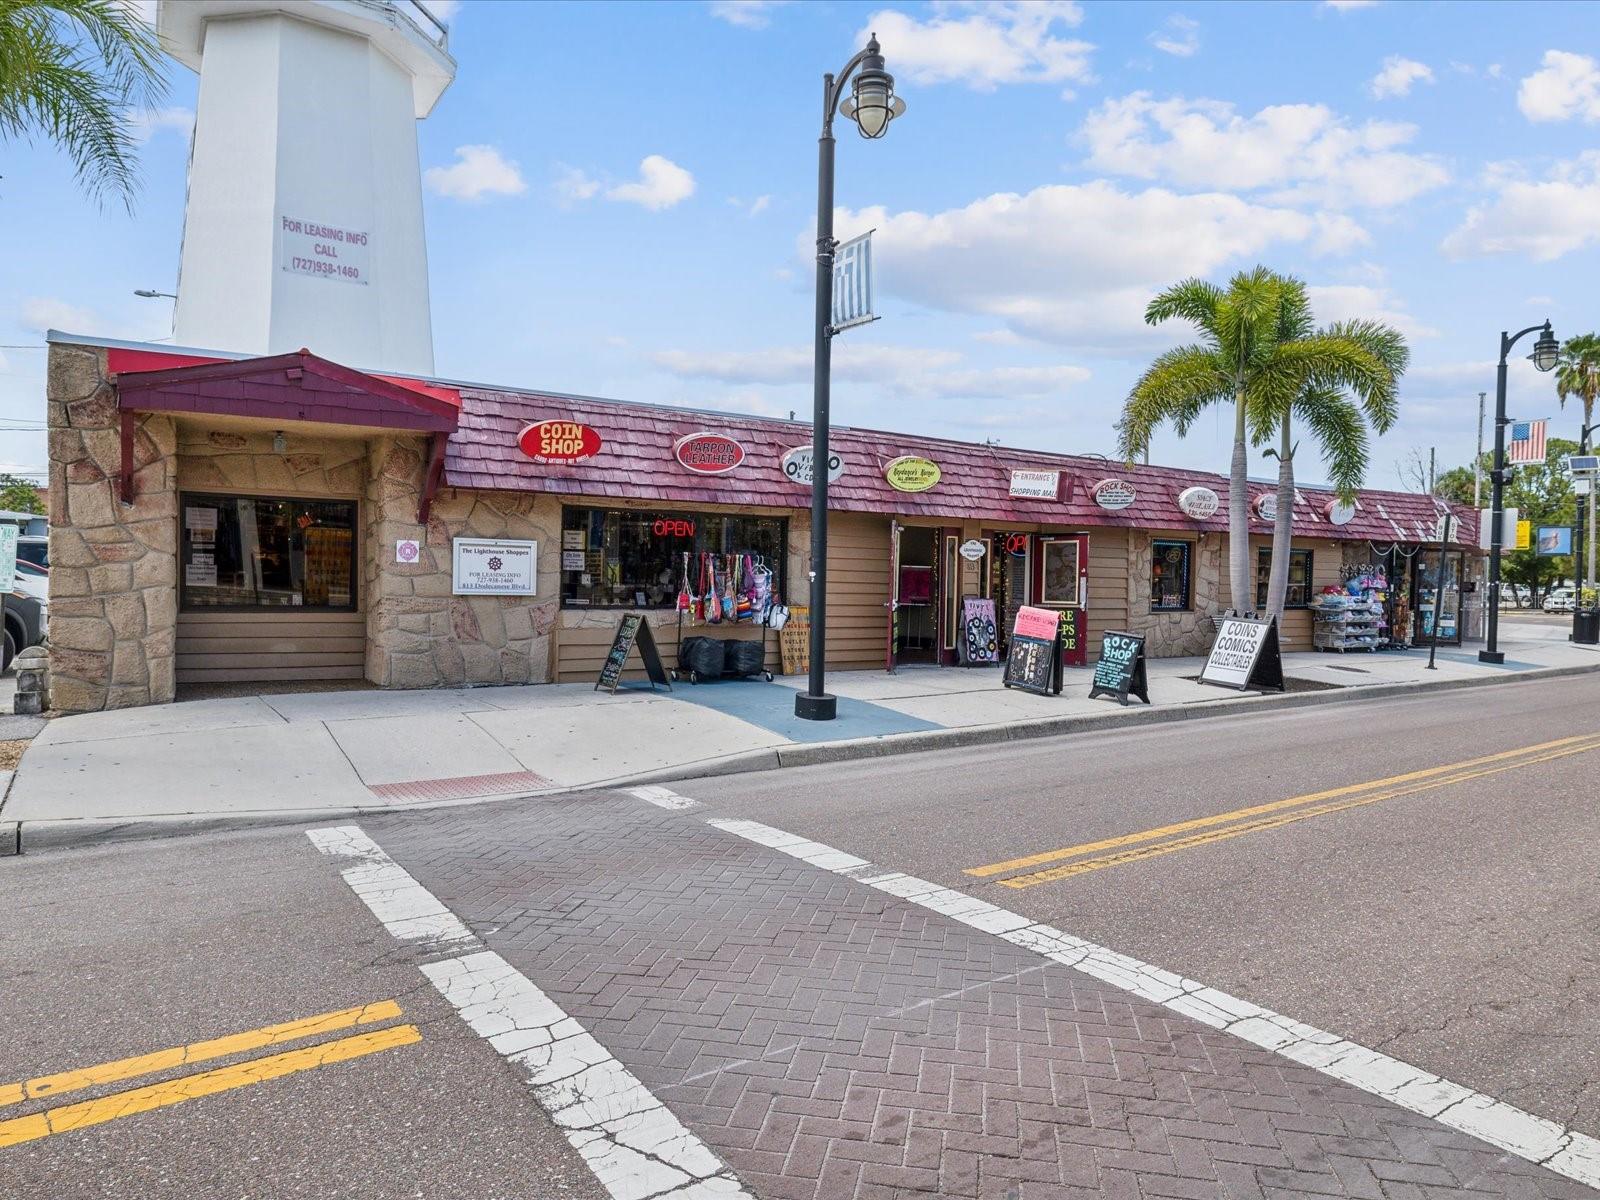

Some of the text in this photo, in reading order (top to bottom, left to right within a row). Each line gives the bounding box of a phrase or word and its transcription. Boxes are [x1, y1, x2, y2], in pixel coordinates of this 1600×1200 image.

[282, 219, 367, 246] FOR LEASING INFO
[314, 243, 338, 258] CALL
[292, 256, 360, 279] (727)938-1460
[540, 423, 583, 439] COIN
[540, 438, 584, 455] SHOP
[688, 442, 735, 454] TARPON
[685, 453, 736, 465] LEATHER
[1020, 473, 1051, 482] ENTRANCE
[1010, 487, 1057, 498] SHOPPING MALL
[1099, 482, 1136, 495] ROCK SHOP
[654, 519, 695, 537] OPEN
[474, 548, 505, 556] Lighthouse
[1060, 610, 1074, 621] RE
[1062, 624, 1075, 636] PS
[1227, 622, 1259, 638] COINS
[1062, 638, 1076, 649] DE
[1103, 636, 1139, 653] ROCK
[1217, 636, 1257, 654] COMICS
[1103, 647, 1132, 660] SHOP
[1210, 651, 1253, 670] COLLECTABLES
